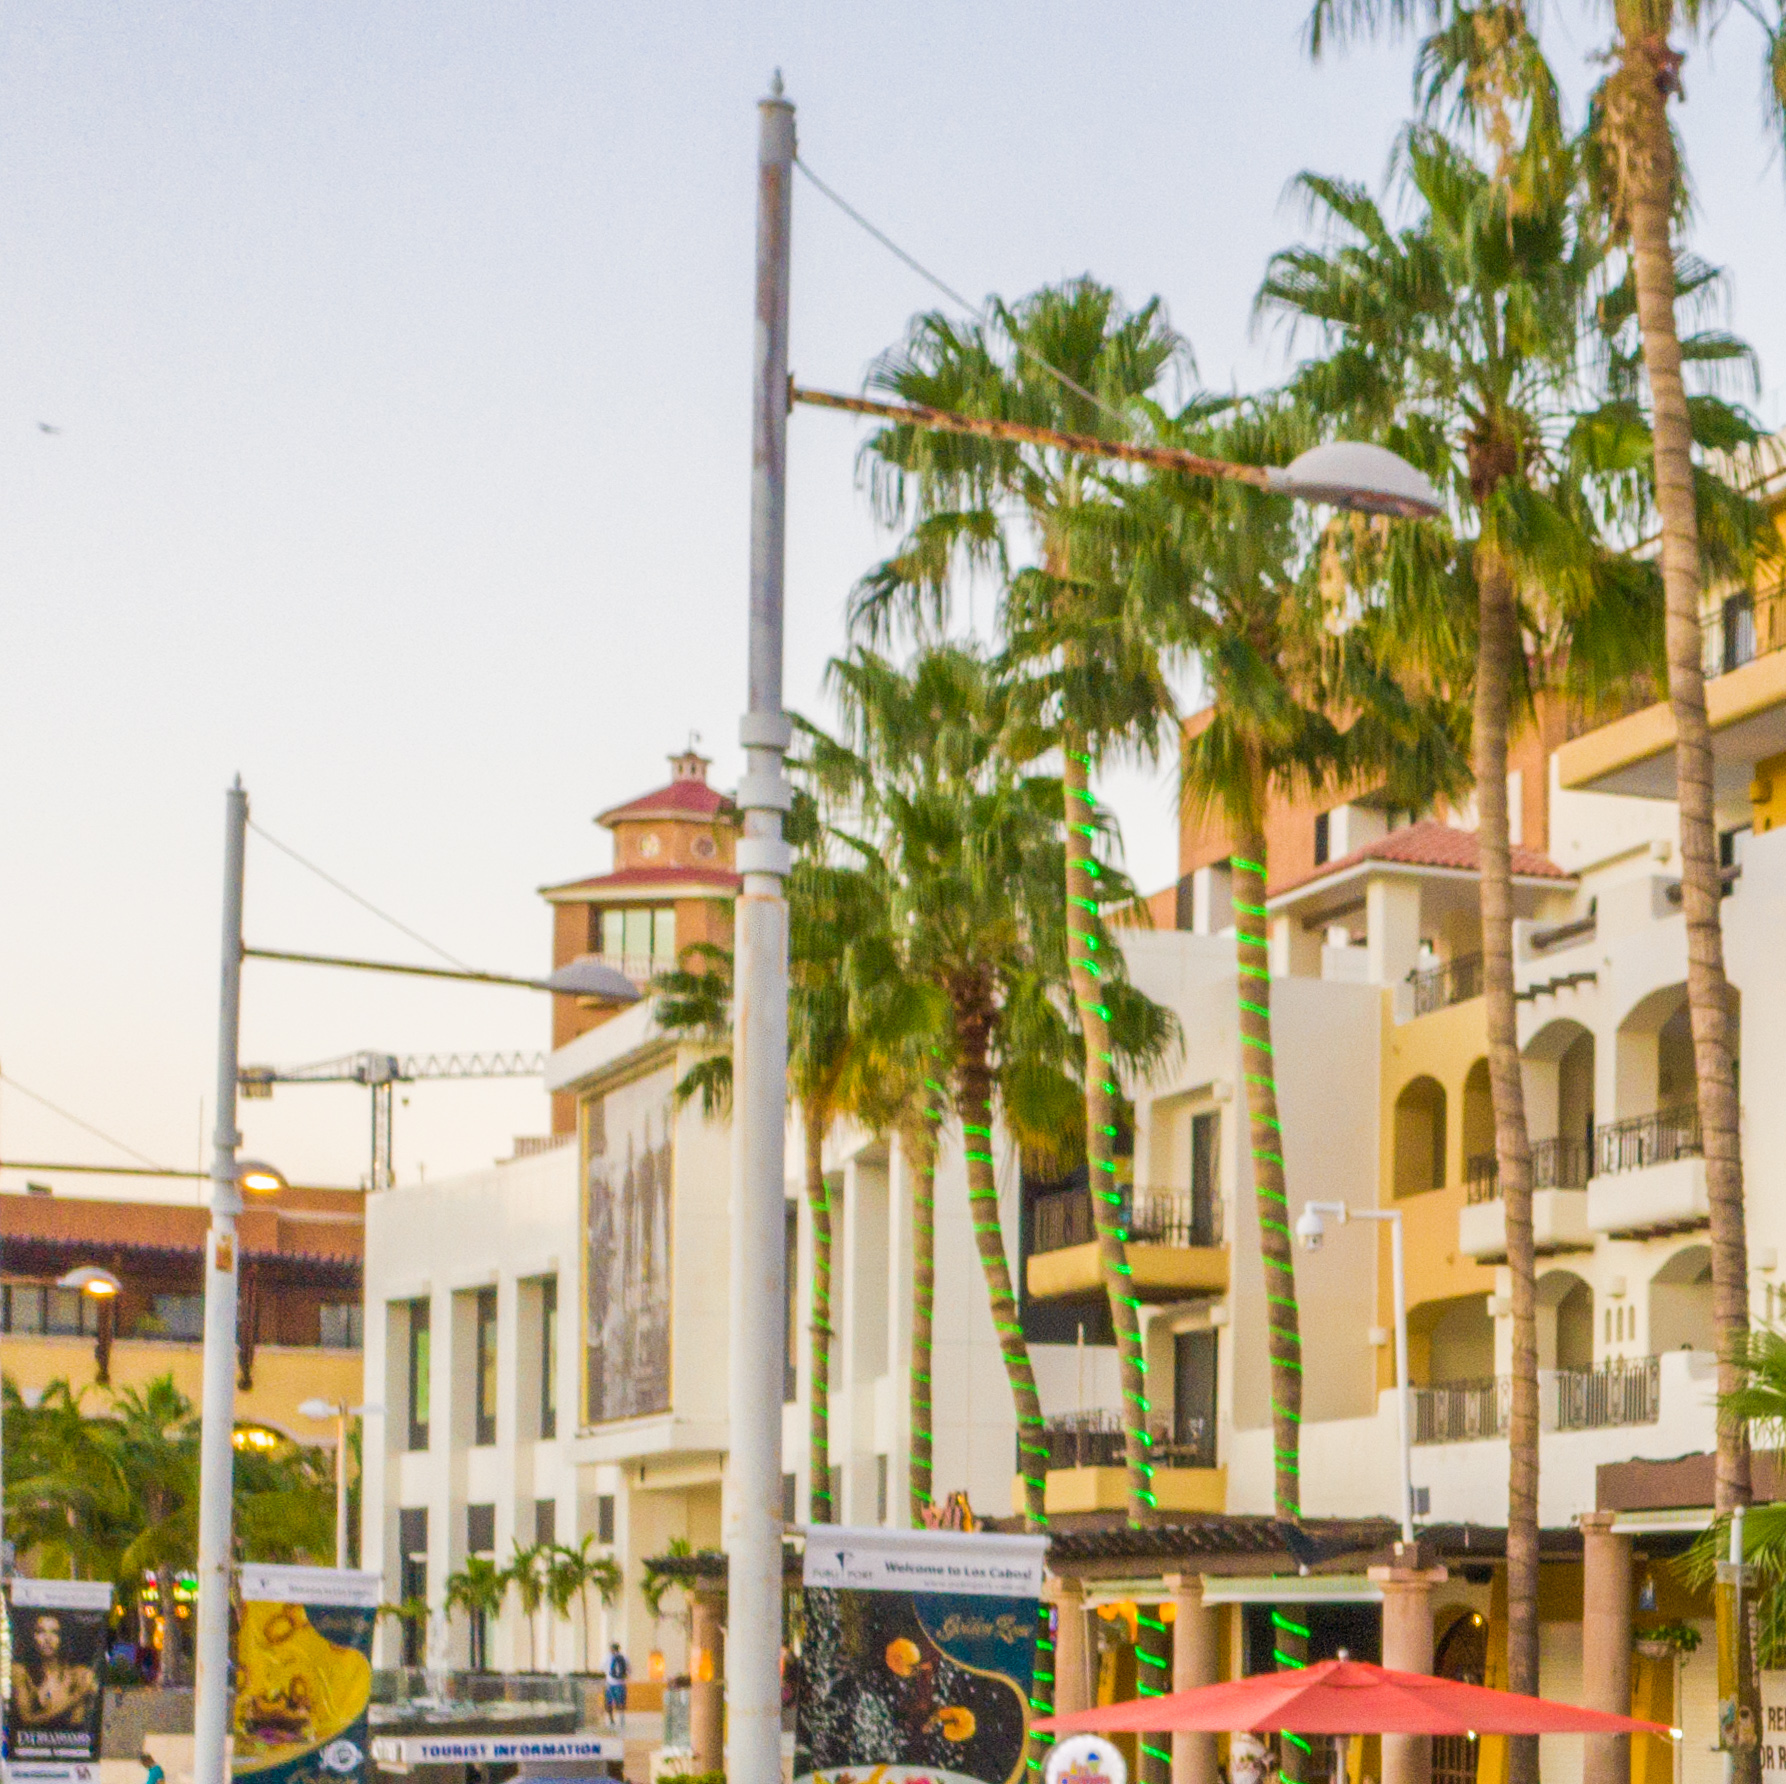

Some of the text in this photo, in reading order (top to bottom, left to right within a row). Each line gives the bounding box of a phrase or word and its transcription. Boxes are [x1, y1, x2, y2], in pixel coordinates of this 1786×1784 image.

[885, 1560, 943, 1575] Welcome
[948, 1564, 961, 1576] to
[964, 1565, 986, 1578] Los
[420, 1742, 603, 1758] TOURIST INFORMATION
